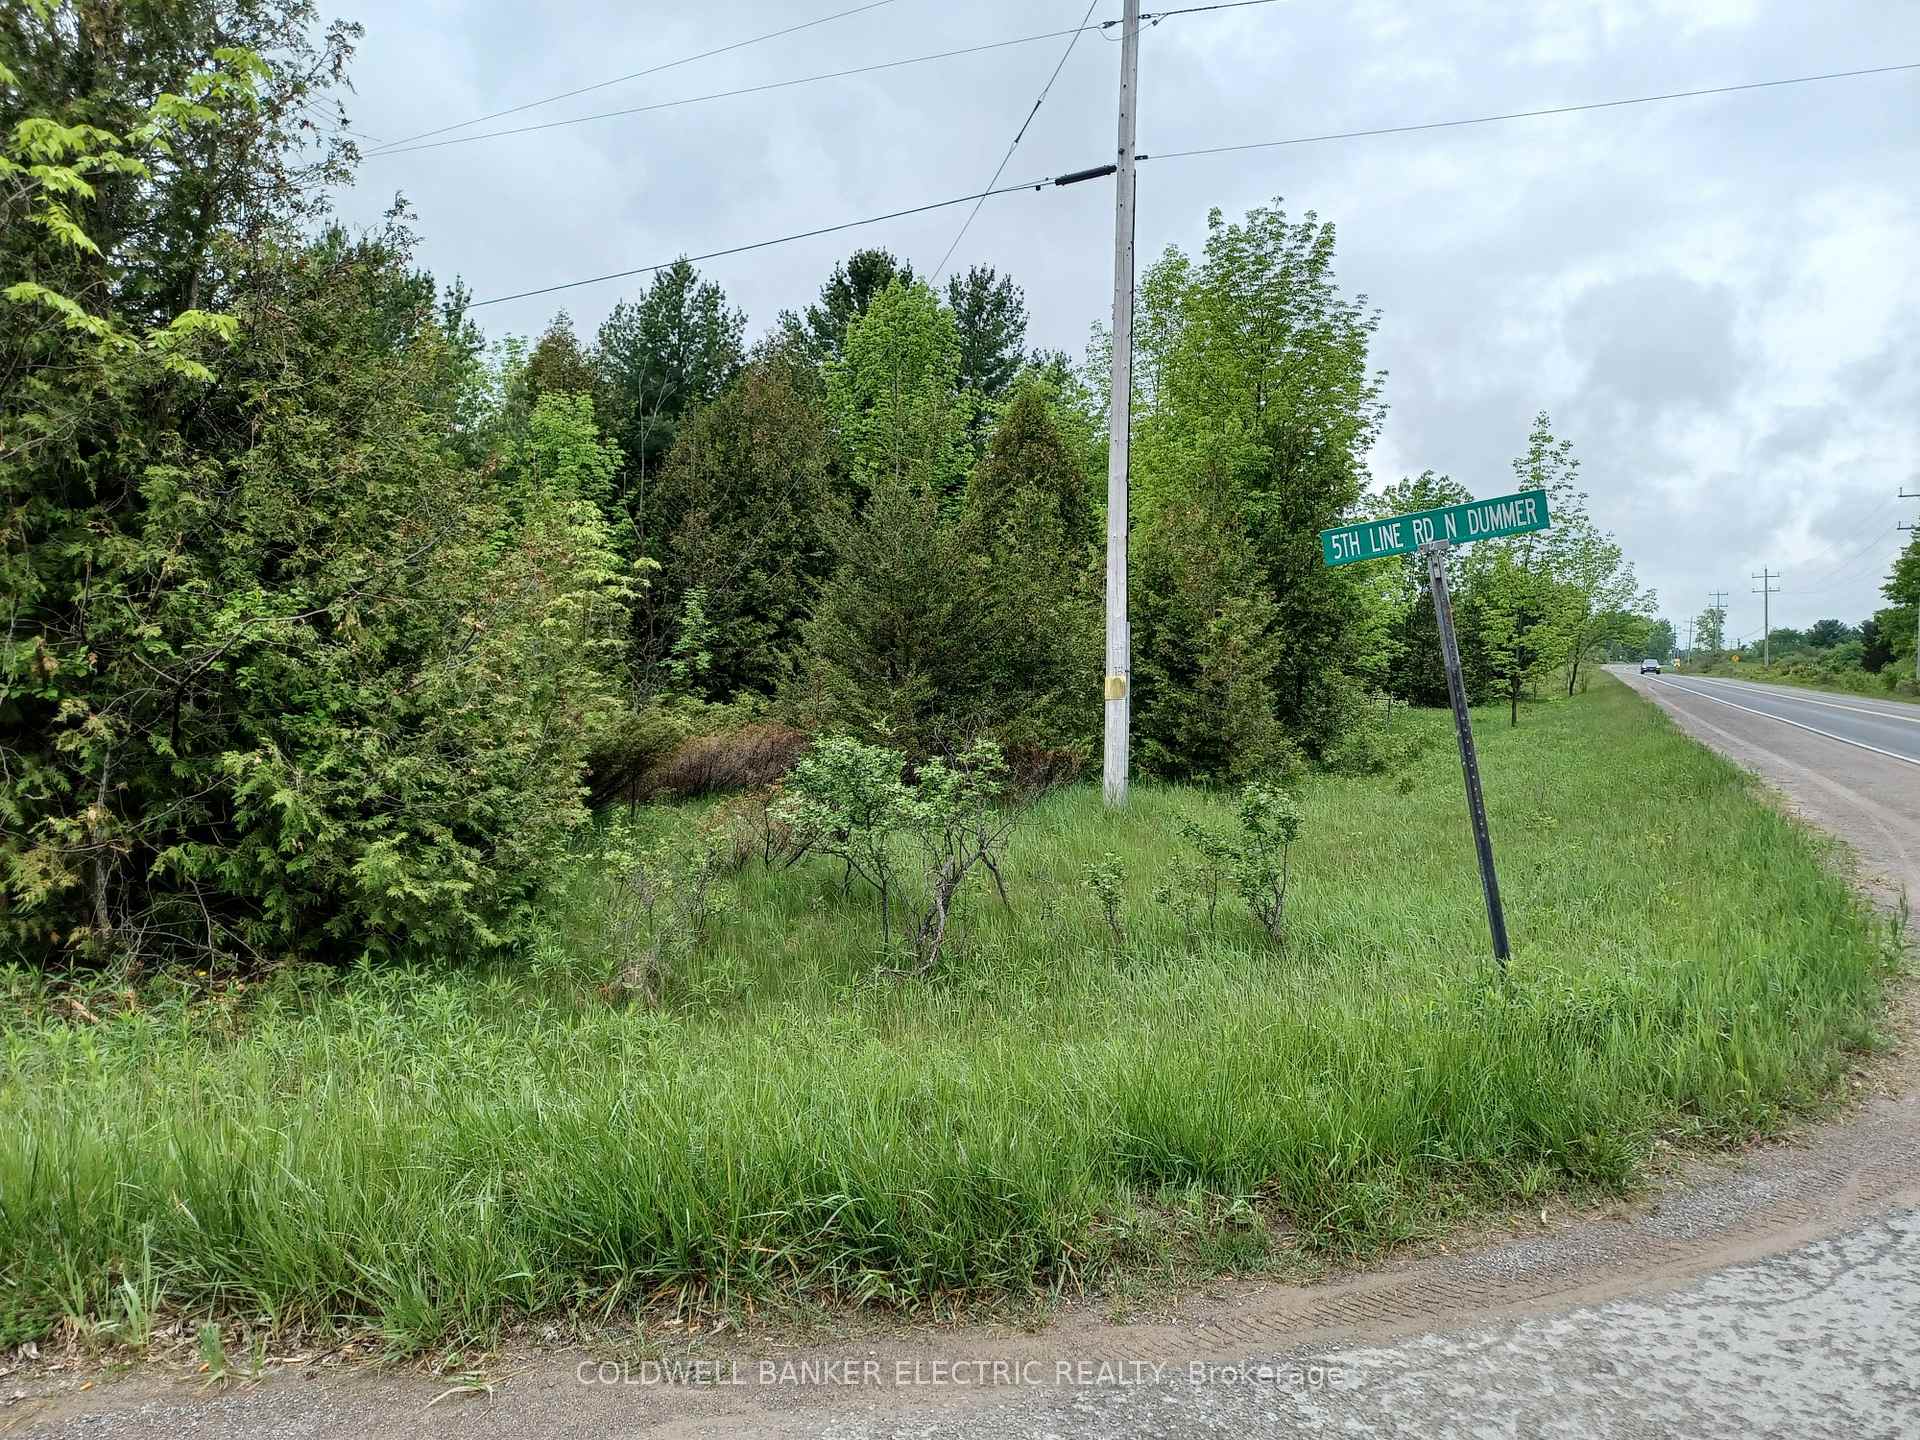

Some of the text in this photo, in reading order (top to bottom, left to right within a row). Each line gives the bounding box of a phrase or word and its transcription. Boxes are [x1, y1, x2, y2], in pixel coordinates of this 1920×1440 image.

[1331, 498, 1538, 560] 5TH LINE RD N DUMMER
